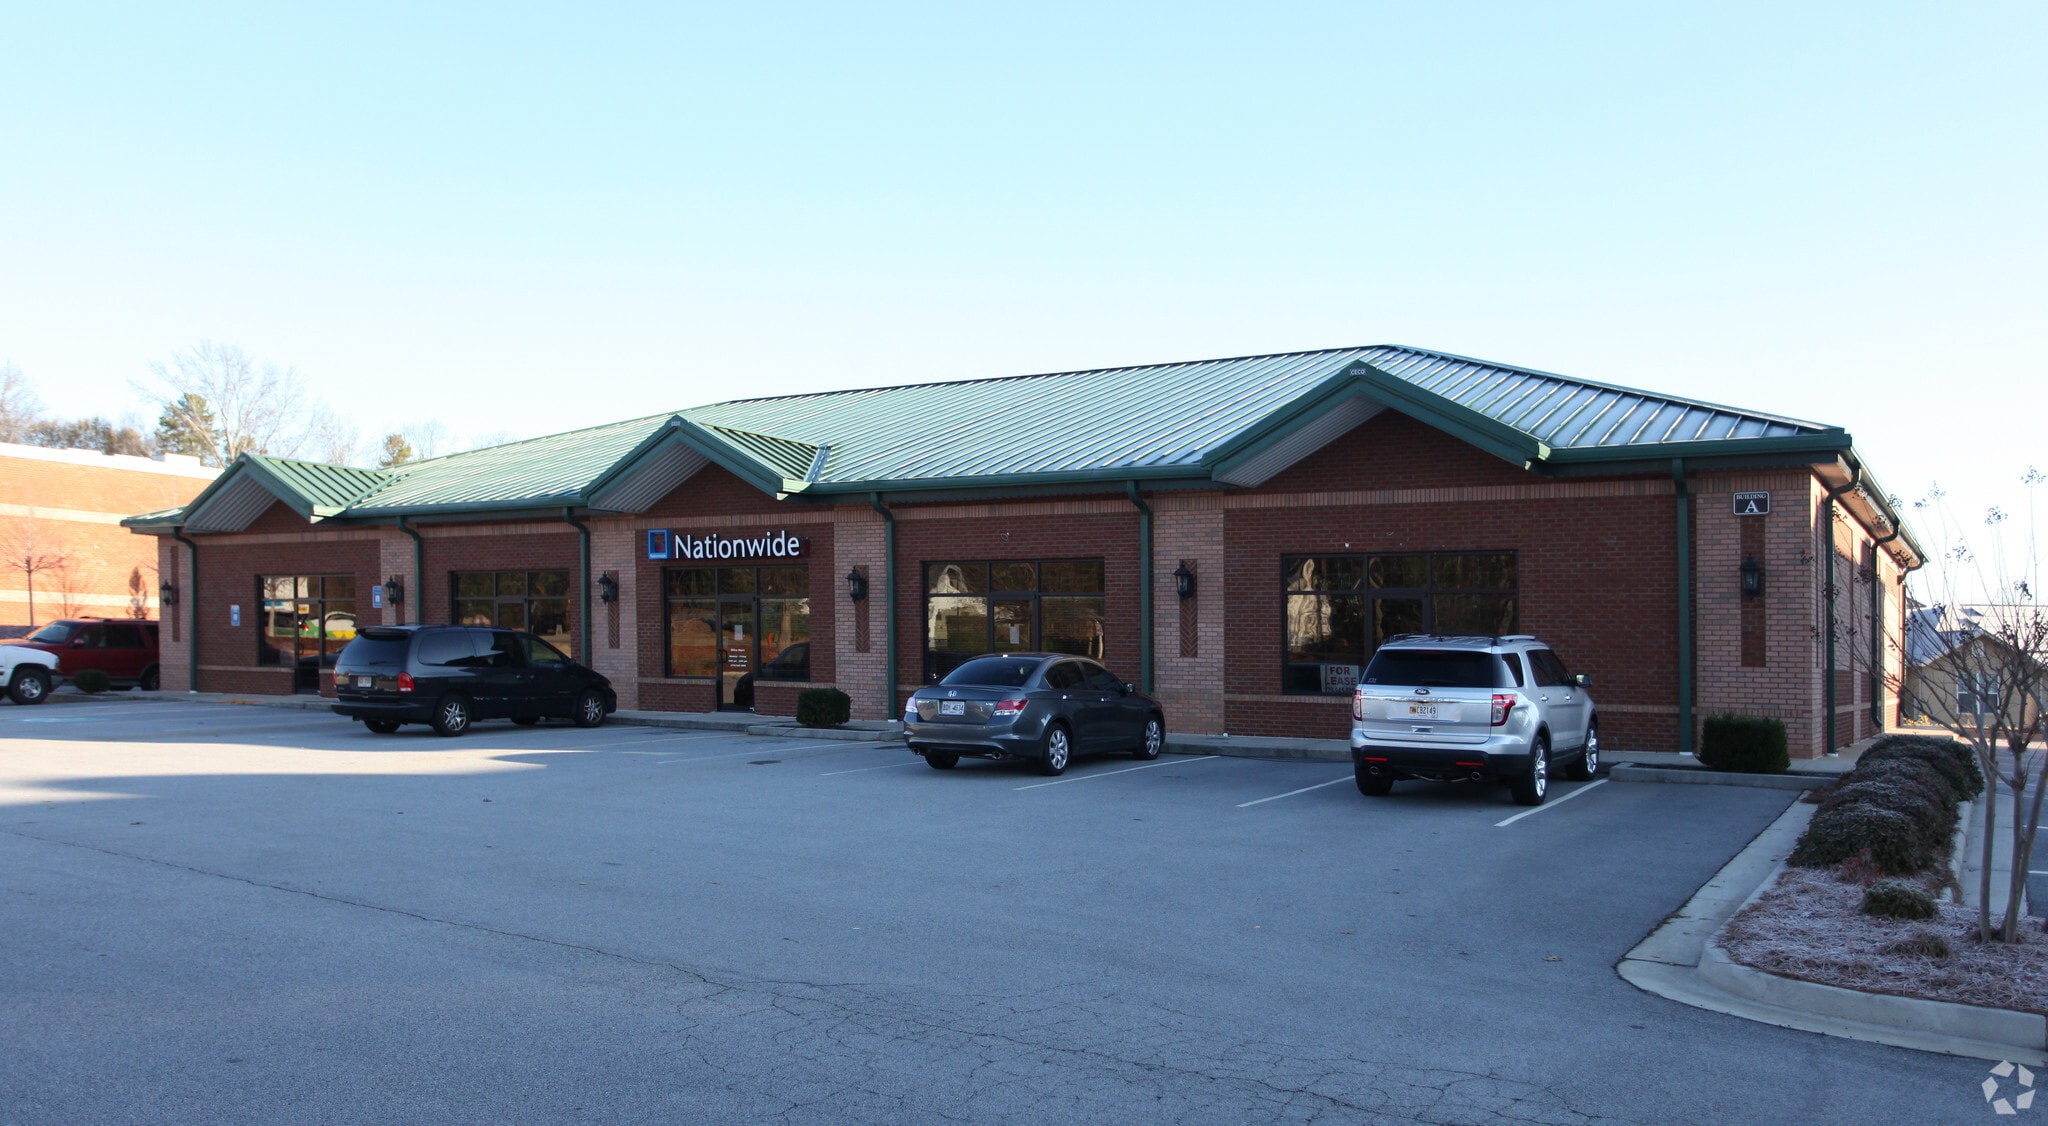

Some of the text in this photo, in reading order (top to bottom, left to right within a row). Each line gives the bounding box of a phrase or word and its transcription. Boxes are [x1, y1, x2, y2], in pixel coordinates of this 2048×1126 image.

[1744, 500, 1759, 513] A
[675, 530, 800, 559] Nationwide
[1330, 666, 1351, 675] FOR
